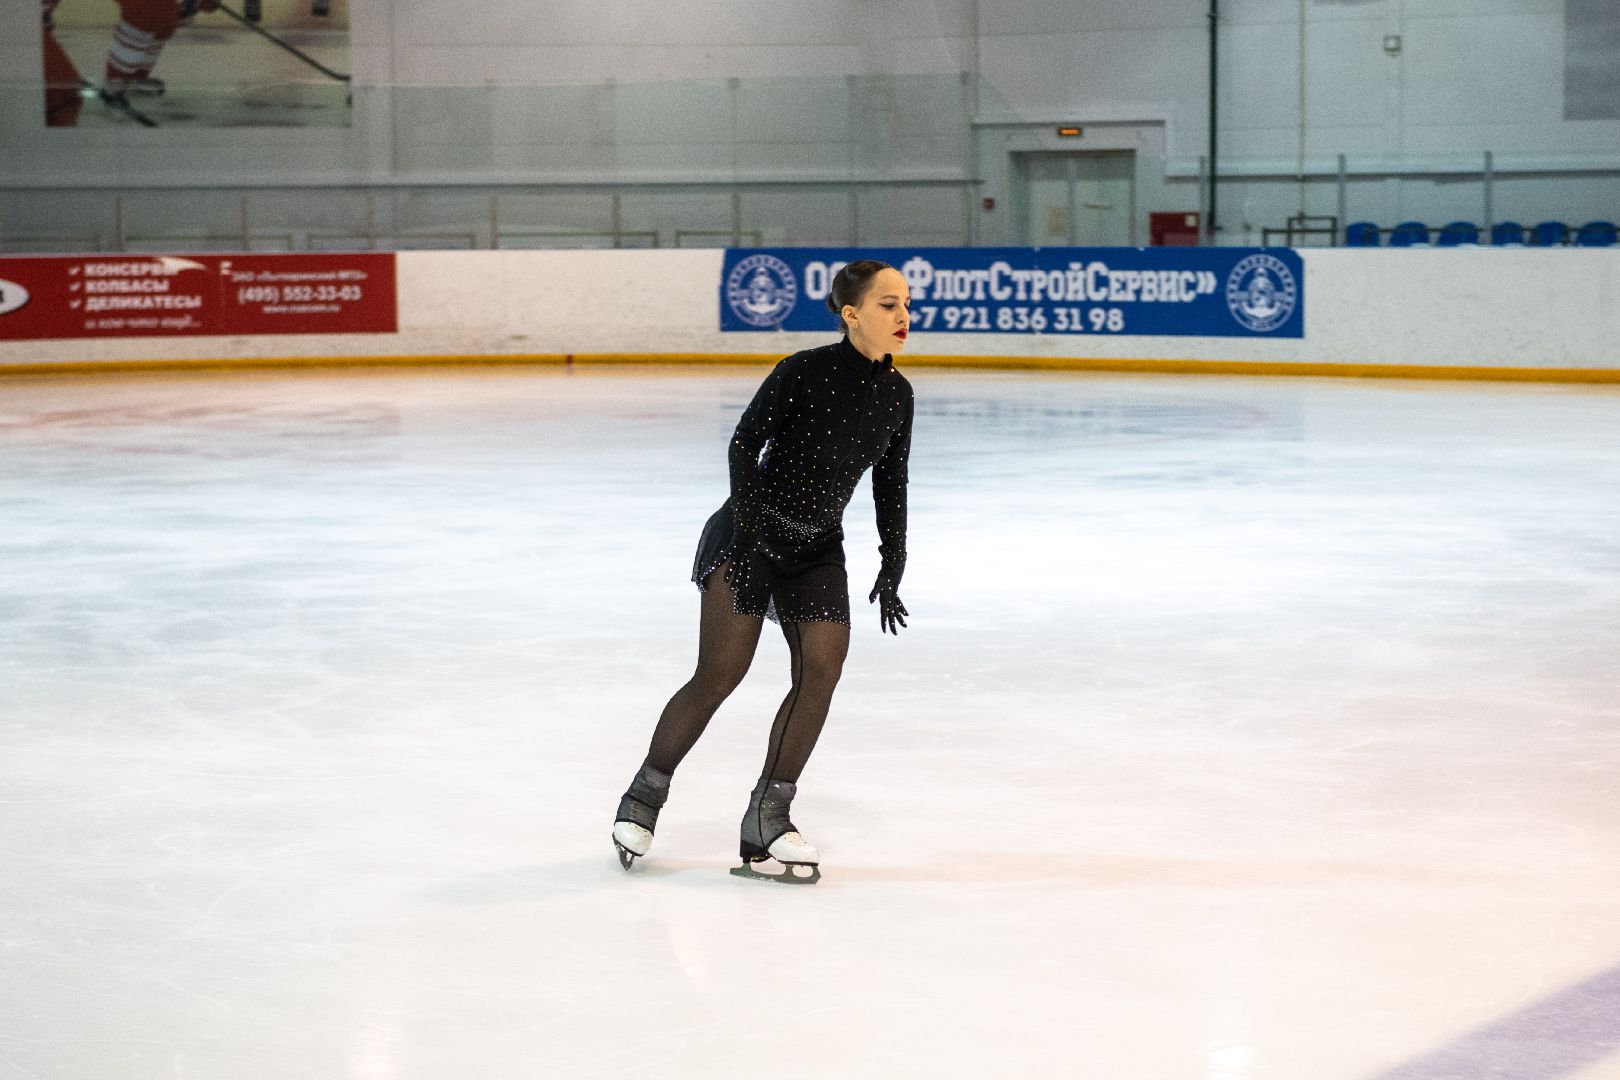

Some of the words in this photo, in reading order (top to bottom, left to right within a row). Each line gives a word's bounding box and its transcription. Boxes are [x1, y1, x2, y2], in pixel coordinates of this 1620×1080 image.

[85, 279, 169, 293] КОЛБАСЫ
[238, 287, 280, 304] (495)
[283, 285, 362, 301] 552-33-03
[85, 295, 202, 312] ДЕЛИКАТЕСЫ
[943, 307, 992, 330] 921
[996, 308, 1048, 331] 836
[1053, 308, 1084, 331] 31
[1089, 308, 1125, 331] 98
